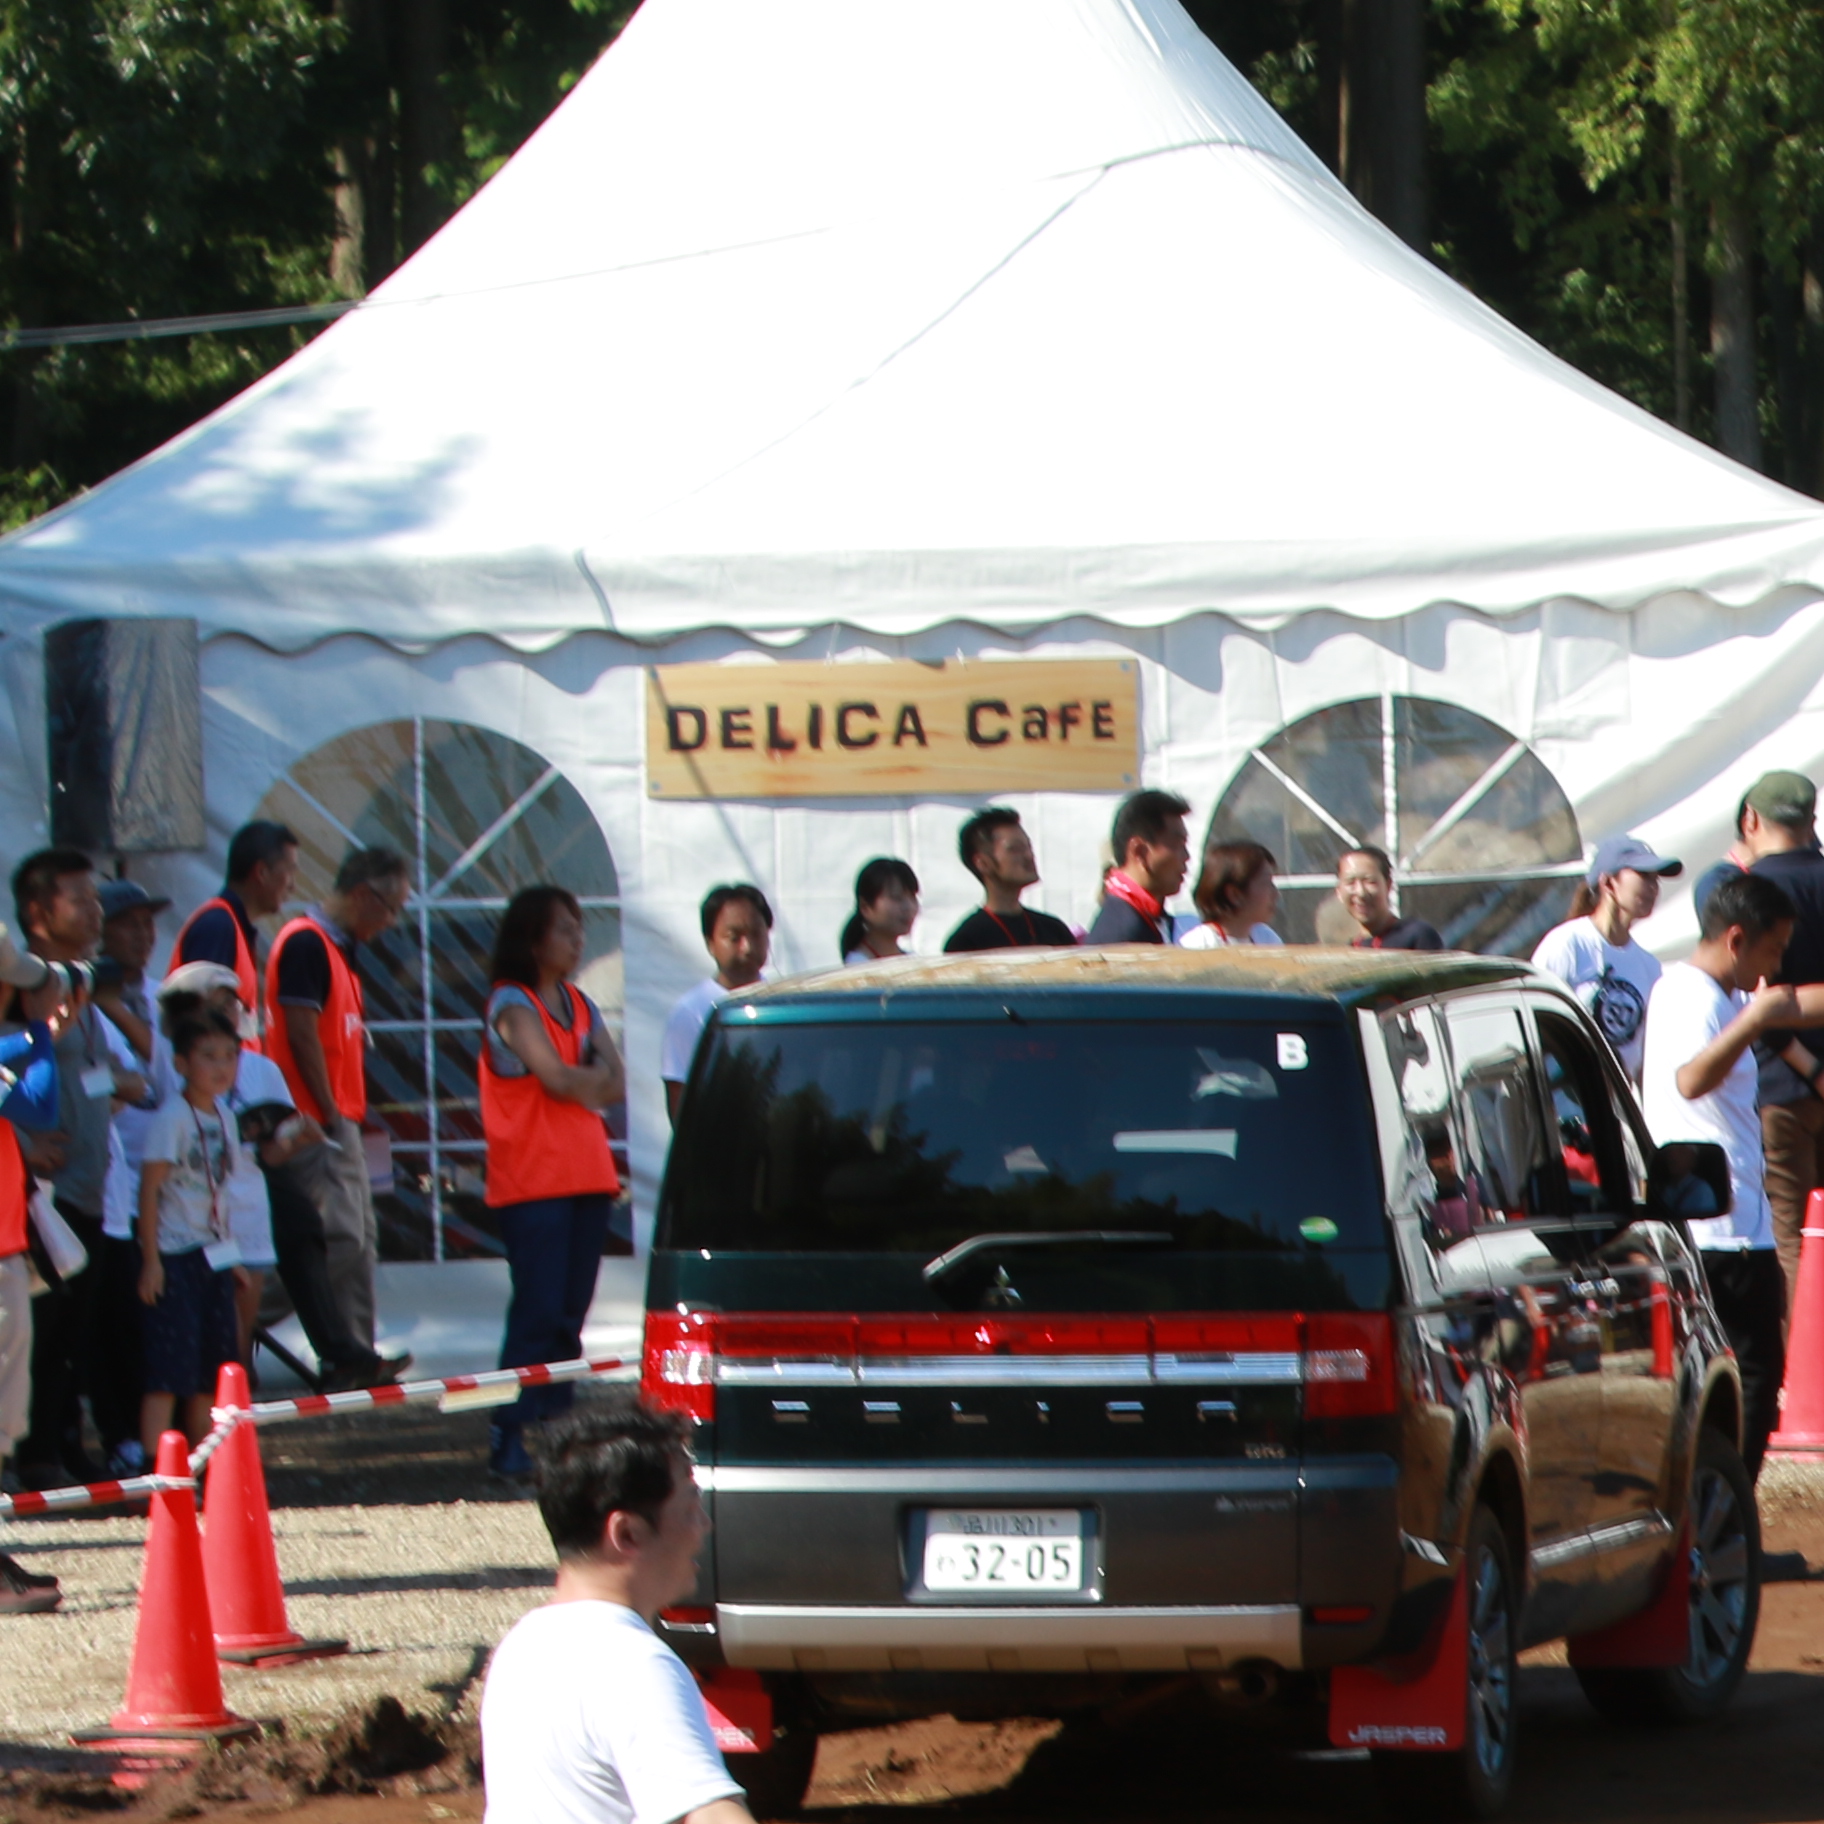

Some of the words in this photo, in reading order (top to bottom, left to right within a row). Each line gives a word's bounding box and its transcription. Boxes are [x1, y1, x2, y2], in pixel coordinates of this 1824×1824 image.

[666, 702, 929, 752] DELICA
[1276, 1032, 1310, 1070] B
[771, 1400, 1238, 1425] DELICA
[962, 1542, 1073, 1581] 32-05
[1347, 1724, 1448, 1745] JASPER
